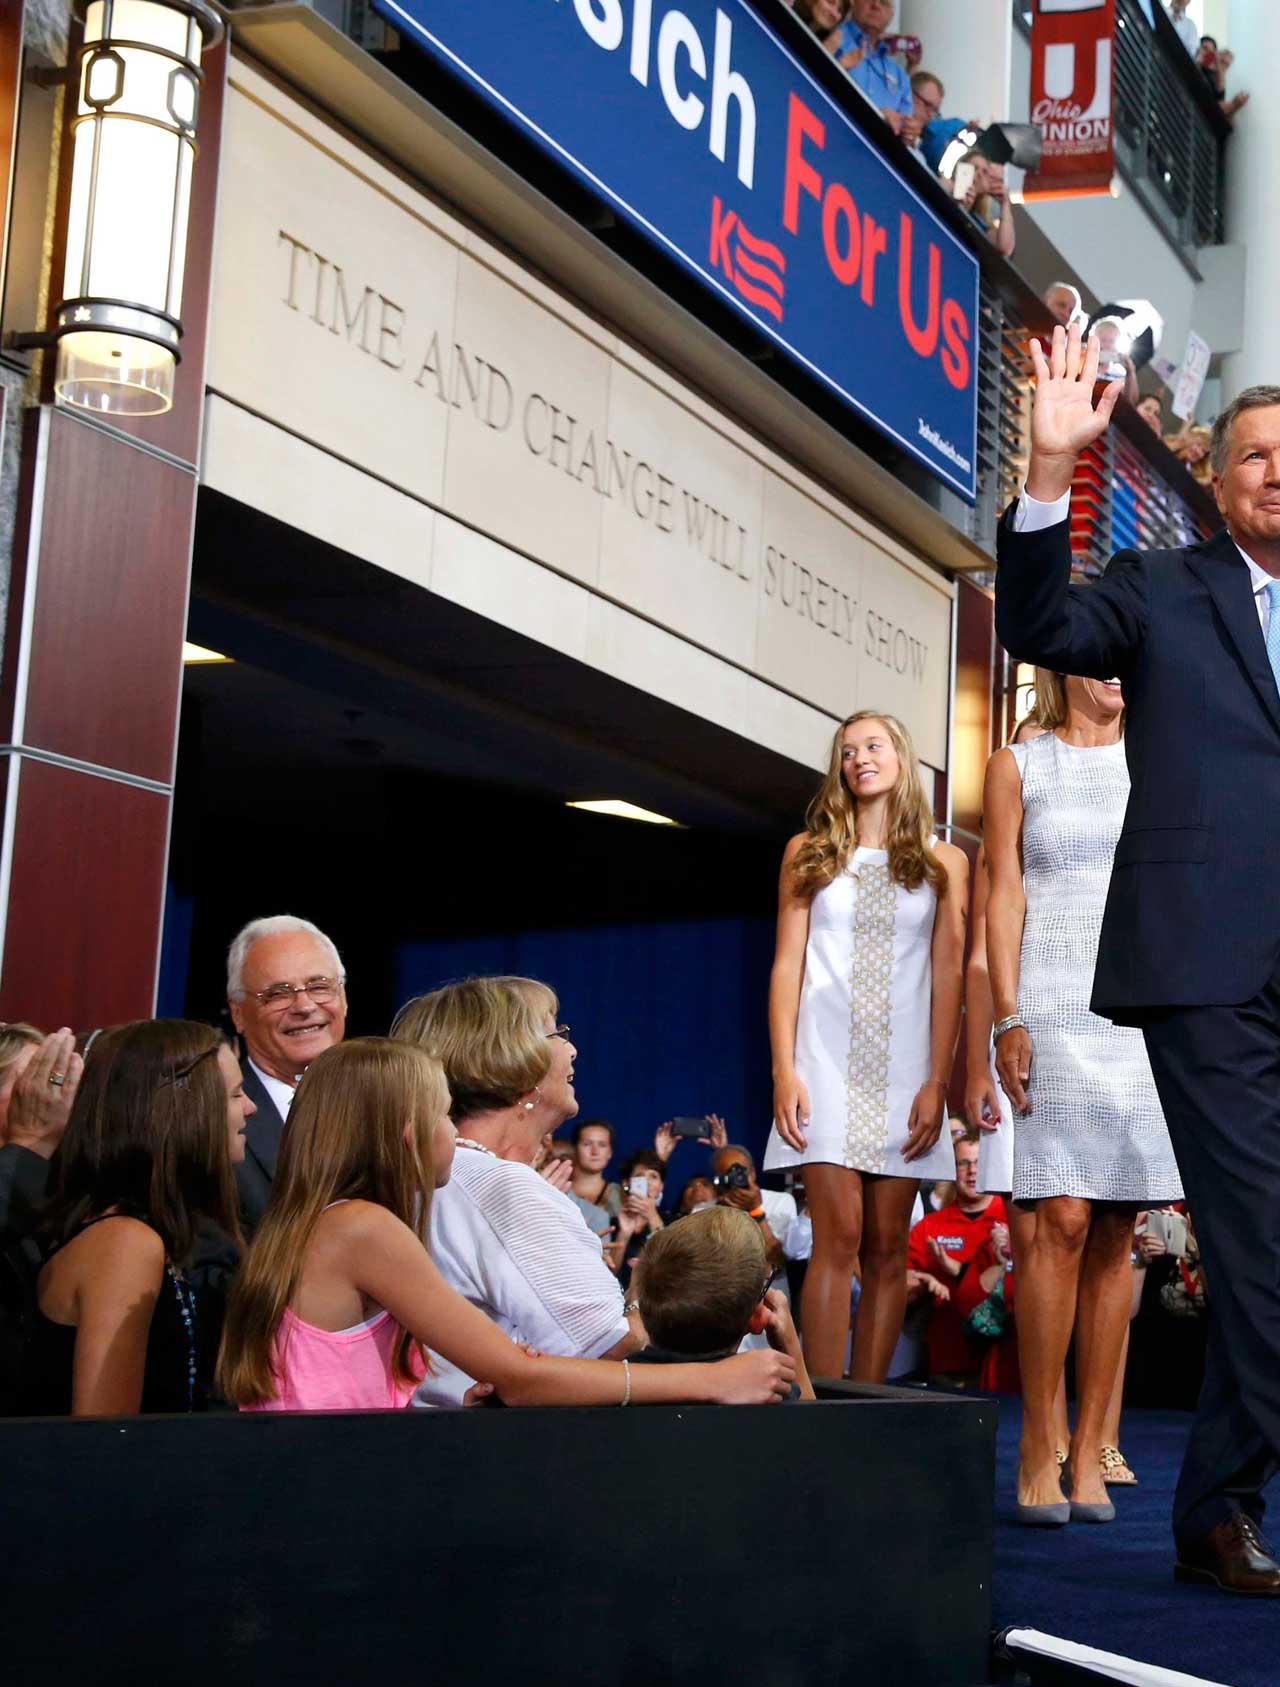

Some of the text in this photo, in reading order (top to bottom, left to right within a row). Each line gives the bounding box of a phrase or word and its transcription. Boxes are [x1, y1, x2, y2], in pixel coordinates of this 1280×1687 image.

[783, 90, 970, 390] For Us
[279, 230, 929, 685] TIME AND CHANGE WILL SURELY SHOW
